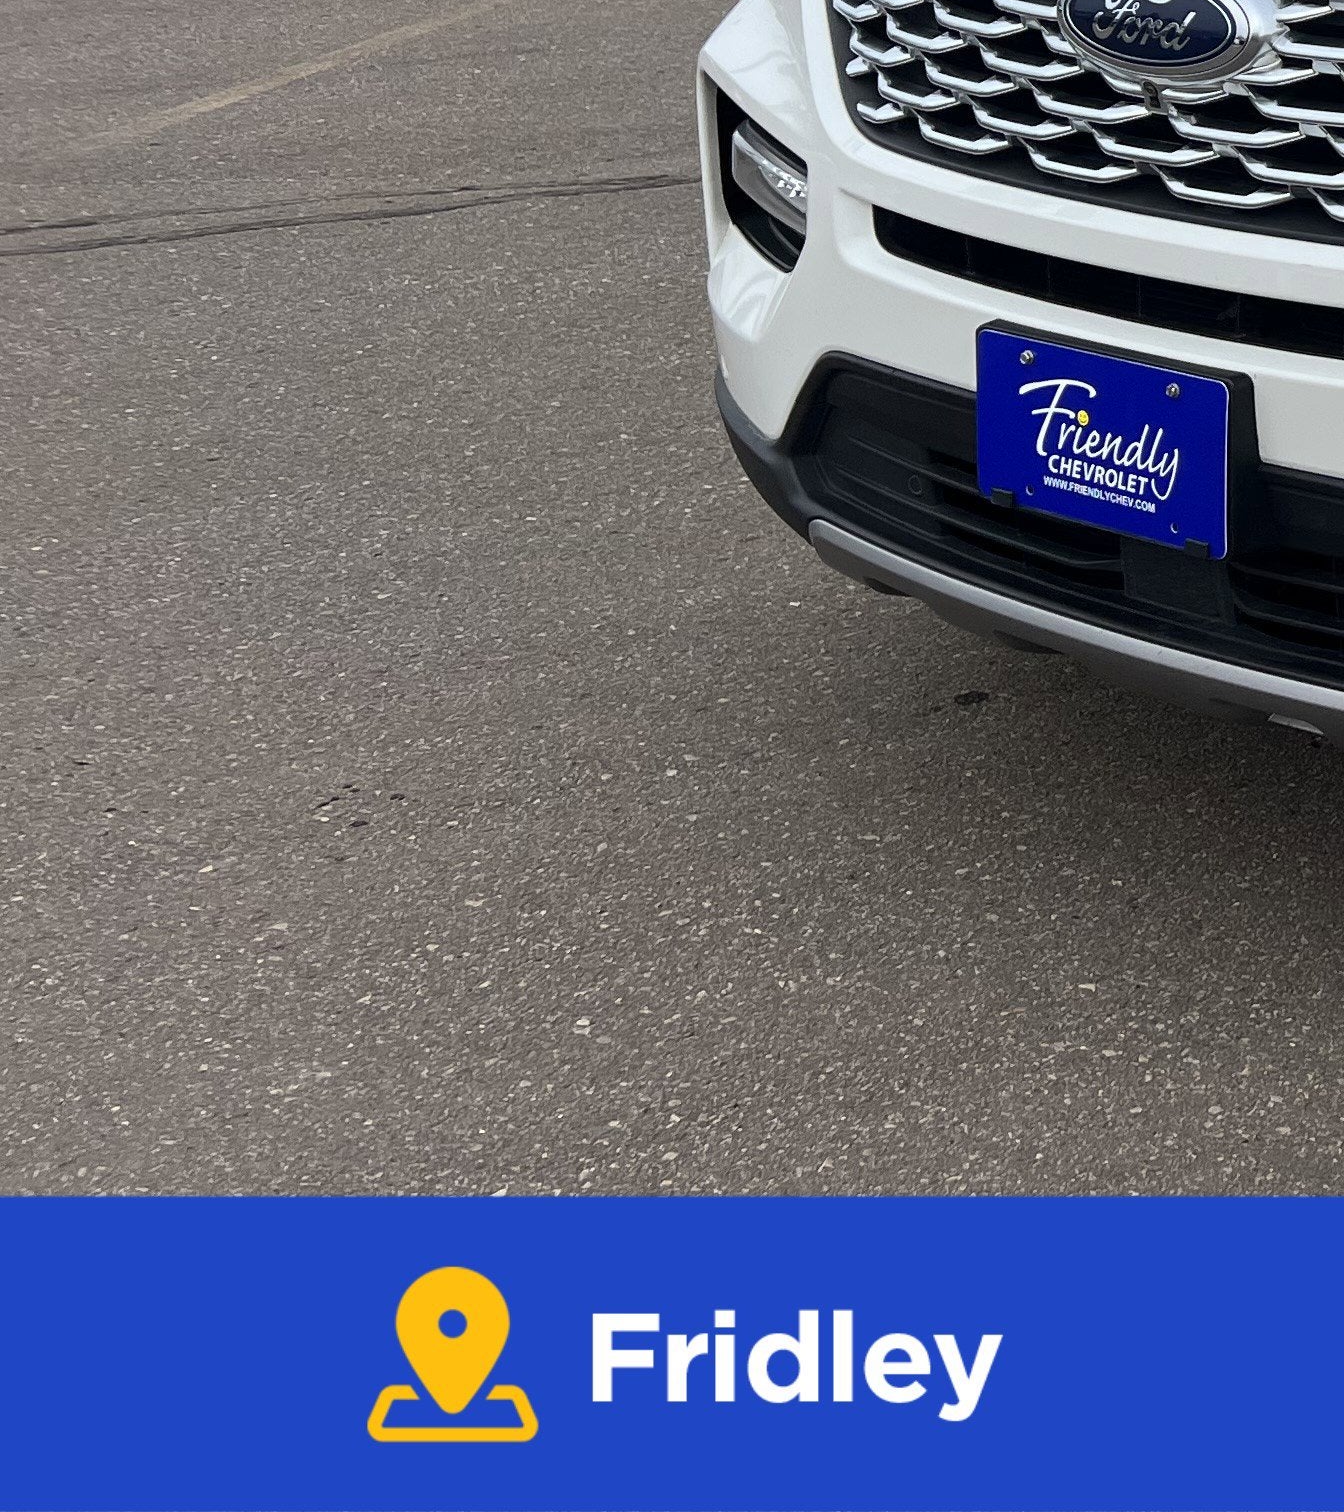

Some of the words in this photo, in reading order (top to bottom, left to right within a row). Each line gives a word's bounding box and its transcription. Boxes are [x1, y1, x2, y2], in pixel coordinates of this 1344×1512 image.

[1018, 378, 1179, 501] Friendly
[1043, 475, 1156, 513] WWW.FRIENDLYCHEV.COM
[1048, 454, 1149, 496] CHEVROLET
